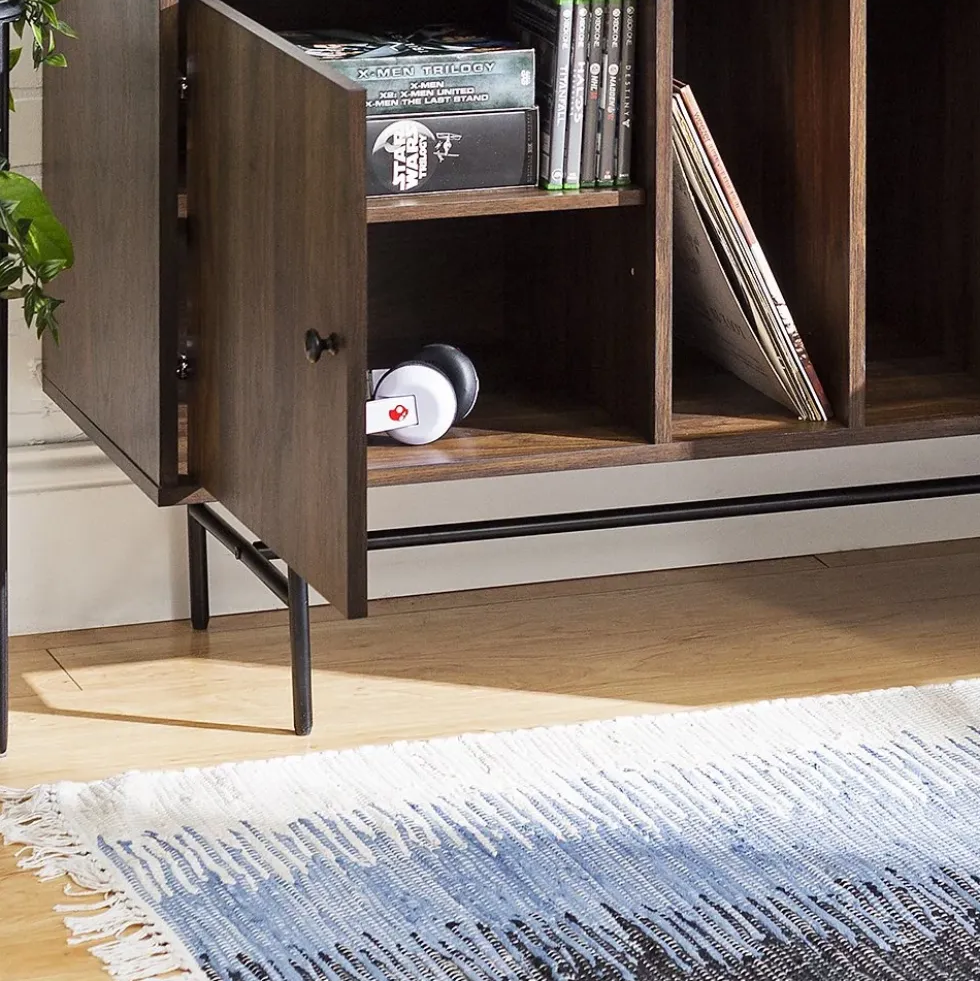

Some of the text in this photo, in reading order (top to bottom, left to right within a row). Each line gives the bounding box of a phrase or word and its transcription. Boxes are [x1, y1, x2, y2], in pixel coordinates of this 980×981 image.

[358, 62, 496, 80] X-MEN TRILOGY
[410, 81, 445, 89] X-MEN
[590, 75, 599, 91] NHL
[366, 94, 489, 108] X-MEN THE LAST STAND
[400, 89, 435, 98] X-MEN
[436, 87, 475, 96] UNITED
[556, 65, 568, 127] TITANFALL
[624, 64, 632, 116] DESTINY
[392, 132, 406, 191] STAR
[405, 125, 419, 191] WARS
[418, 134, 428, 180] TRILOGY
